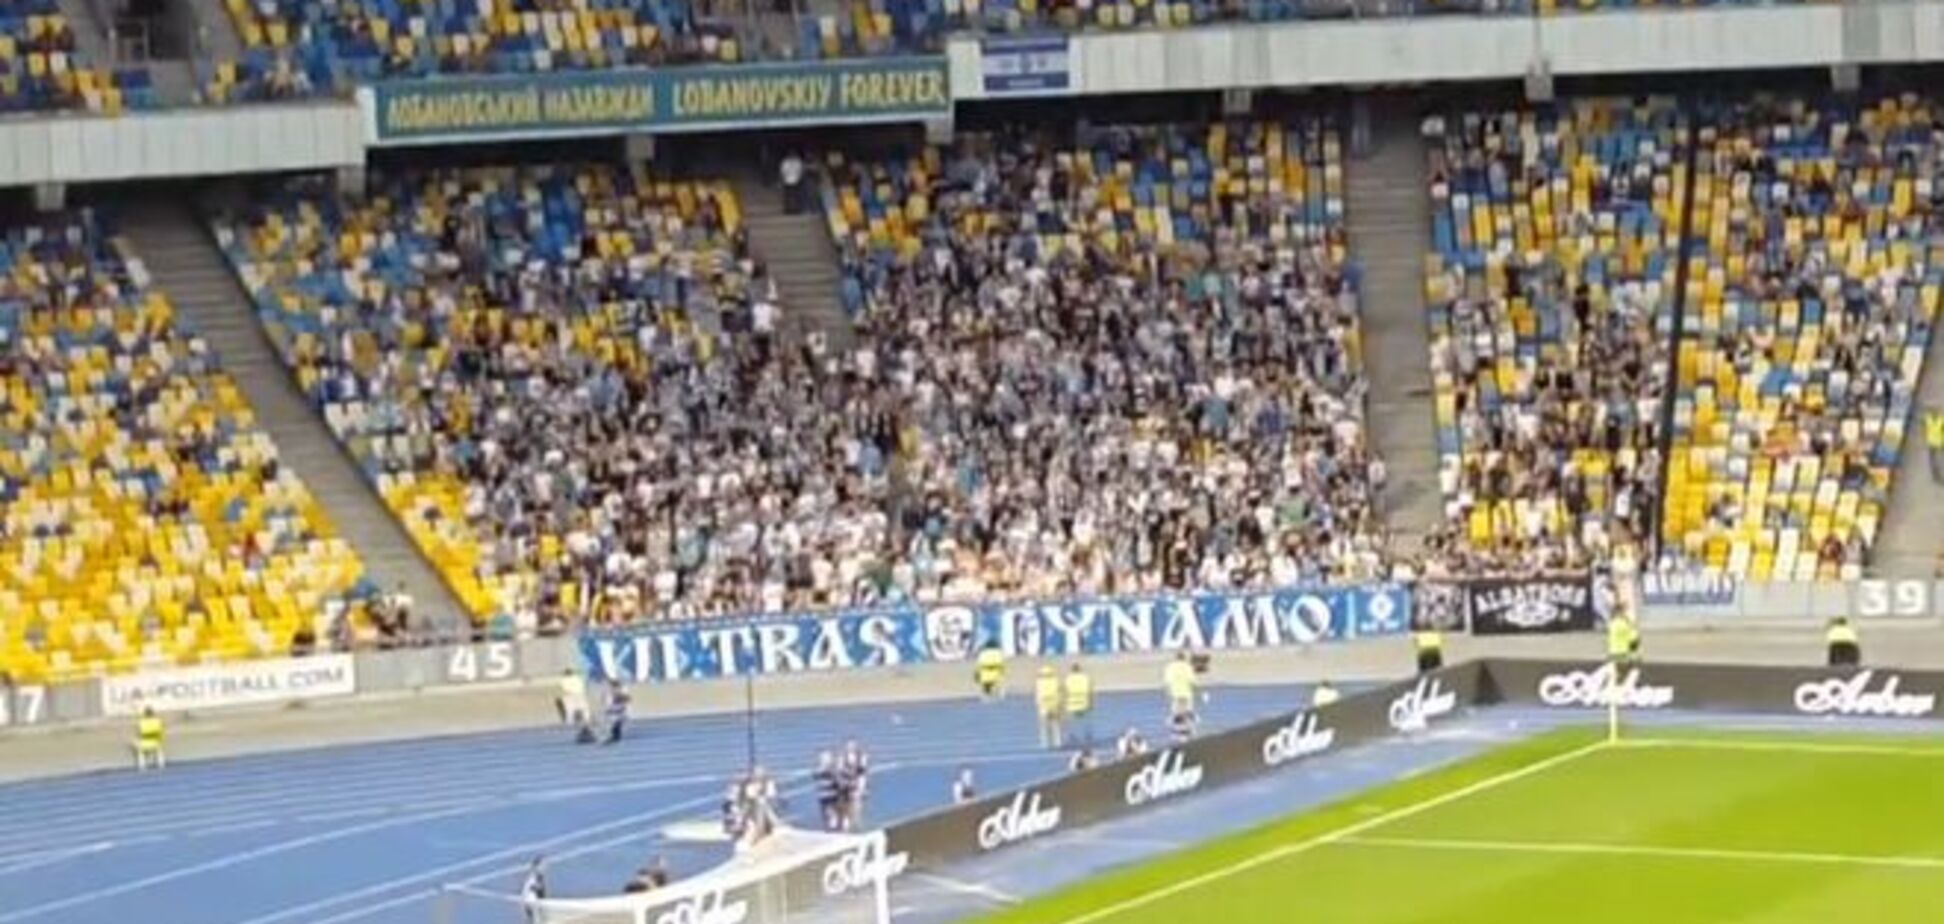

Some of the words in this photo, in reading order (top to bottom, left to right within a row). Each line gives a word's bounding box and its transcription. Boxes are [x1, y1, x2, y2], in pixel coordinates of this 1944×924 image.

[672, 74, 830, 115] LOBANOVSKIY
[839, 70, 945, 106] FOREVER
[1859, 579, 1927, 616] 39
[595, 615, 902, 682] ULTRAS
[1000, 594, 1332, 657] DYNAMO
[450, 642, 514, 681] 45
